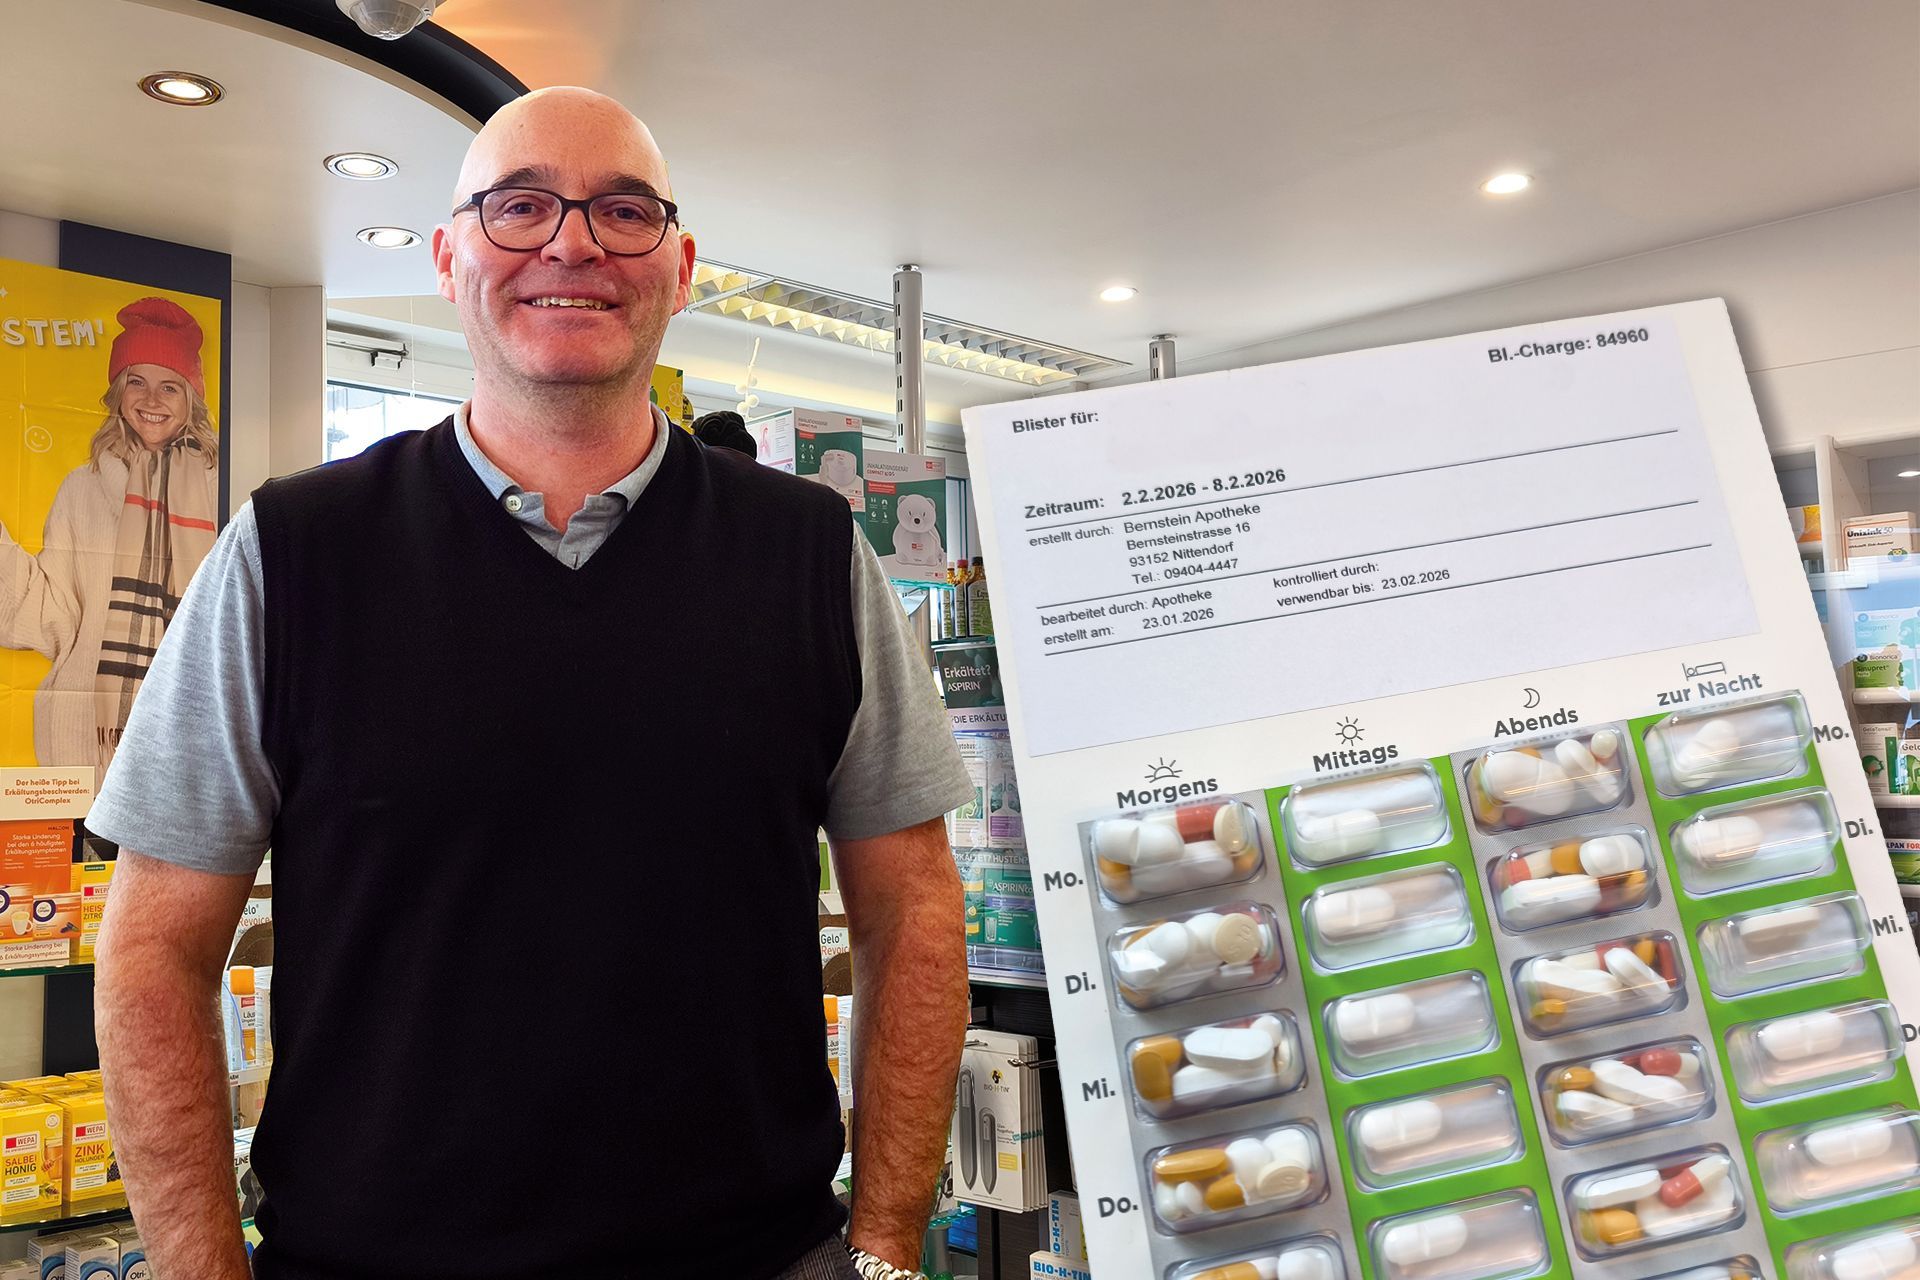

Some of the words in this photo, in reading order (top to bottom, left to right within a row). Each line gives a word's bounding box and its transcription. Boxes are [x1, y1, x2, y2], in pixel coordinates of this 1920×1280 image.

[1488, 338, 1591, 363] Bl.-Charge:
[1596, 328, 1649, 348] 84960
[1012, 415, 1067, 433] Blister
[1070, 411, 1099, 425] für:
[1024, 497, 1105, 519] Zeitraum:
[1122, 482, 1197, 506] 2.2.2026
[1213, 469, 1286, 492] 8.2.2026
[1029, 528, 1073, 547] erstellt
[1075, 526, 1114, 541] durch:
[1123, 514, 1191, 534] Bernstein
[1195, 503, 1261, 524] Apotheke
[1126, 524, 1232, 550] Bernsteinstrasse
[1235, 522, 1250, 533] 16
[1129, 553, 1170, 567] 93152
[1172, 541, 1235, 561] Nittendorf
[1164, 558, 1239, 580] 09404-4447
[1273, 569, 1339, 589] kontrolliert
[1340, 562, 1380, 577] durch:
[1277, 585, 1350, 607] verwendbar
[1352, 582, 1375, 595] bis:
[1381, 569, 1450, 590] 23.02.2026
[1041, 605, 1106, 626] bearbeitet
[1108, 600, 1148, 616] durch:
[1151, 590, 1213, 610] Apotheke
[1044, 628, 1087, 645] erstellt
[1090, 626, 1115, 638] am:
[1142, 607, 1215, 629] 23.01.2026
[944, 664, 991, 679] Erkältet?
[948, 680, 981, 692] ASPIRIN
[1657, 686, 1692, 706] zur
[1699, 673, 1763, 699] Nacht
[1493, 707, 1579, 738] Abends
[1813, 725, 1849, 743] Mo.
[1313, 743, 1399, 772] Mittags
[4, 787, 90, 797] Erkältungsbeschwerden:
[52, 779, 67, 788] Tipp
[1116, 776, 1219, 809] Morgens
[25, 797, 71, 805] OtriComplex
[1844, 818, 1874, 838] Di.
[1043, 871, 1084, 891] Mo.
[1872, 914, 1903, 936] Mi.
[1065, 972, 1096, 994] Di.
[1082, 1078, 1116, 1101] Mi.
[87, 1125, 104, 1134] WEPA
[17, 1136, 35, 1146] WEPA
[75, 1143, 105, 1158] ZINK
[5, 1154, 37, 1167] SALBEI
[5, 1163, 37, 1176] HONIG
[75, 1155, 104, 1163] HOLUNDER
[1098, 1197, 1139, 1218] Do.
